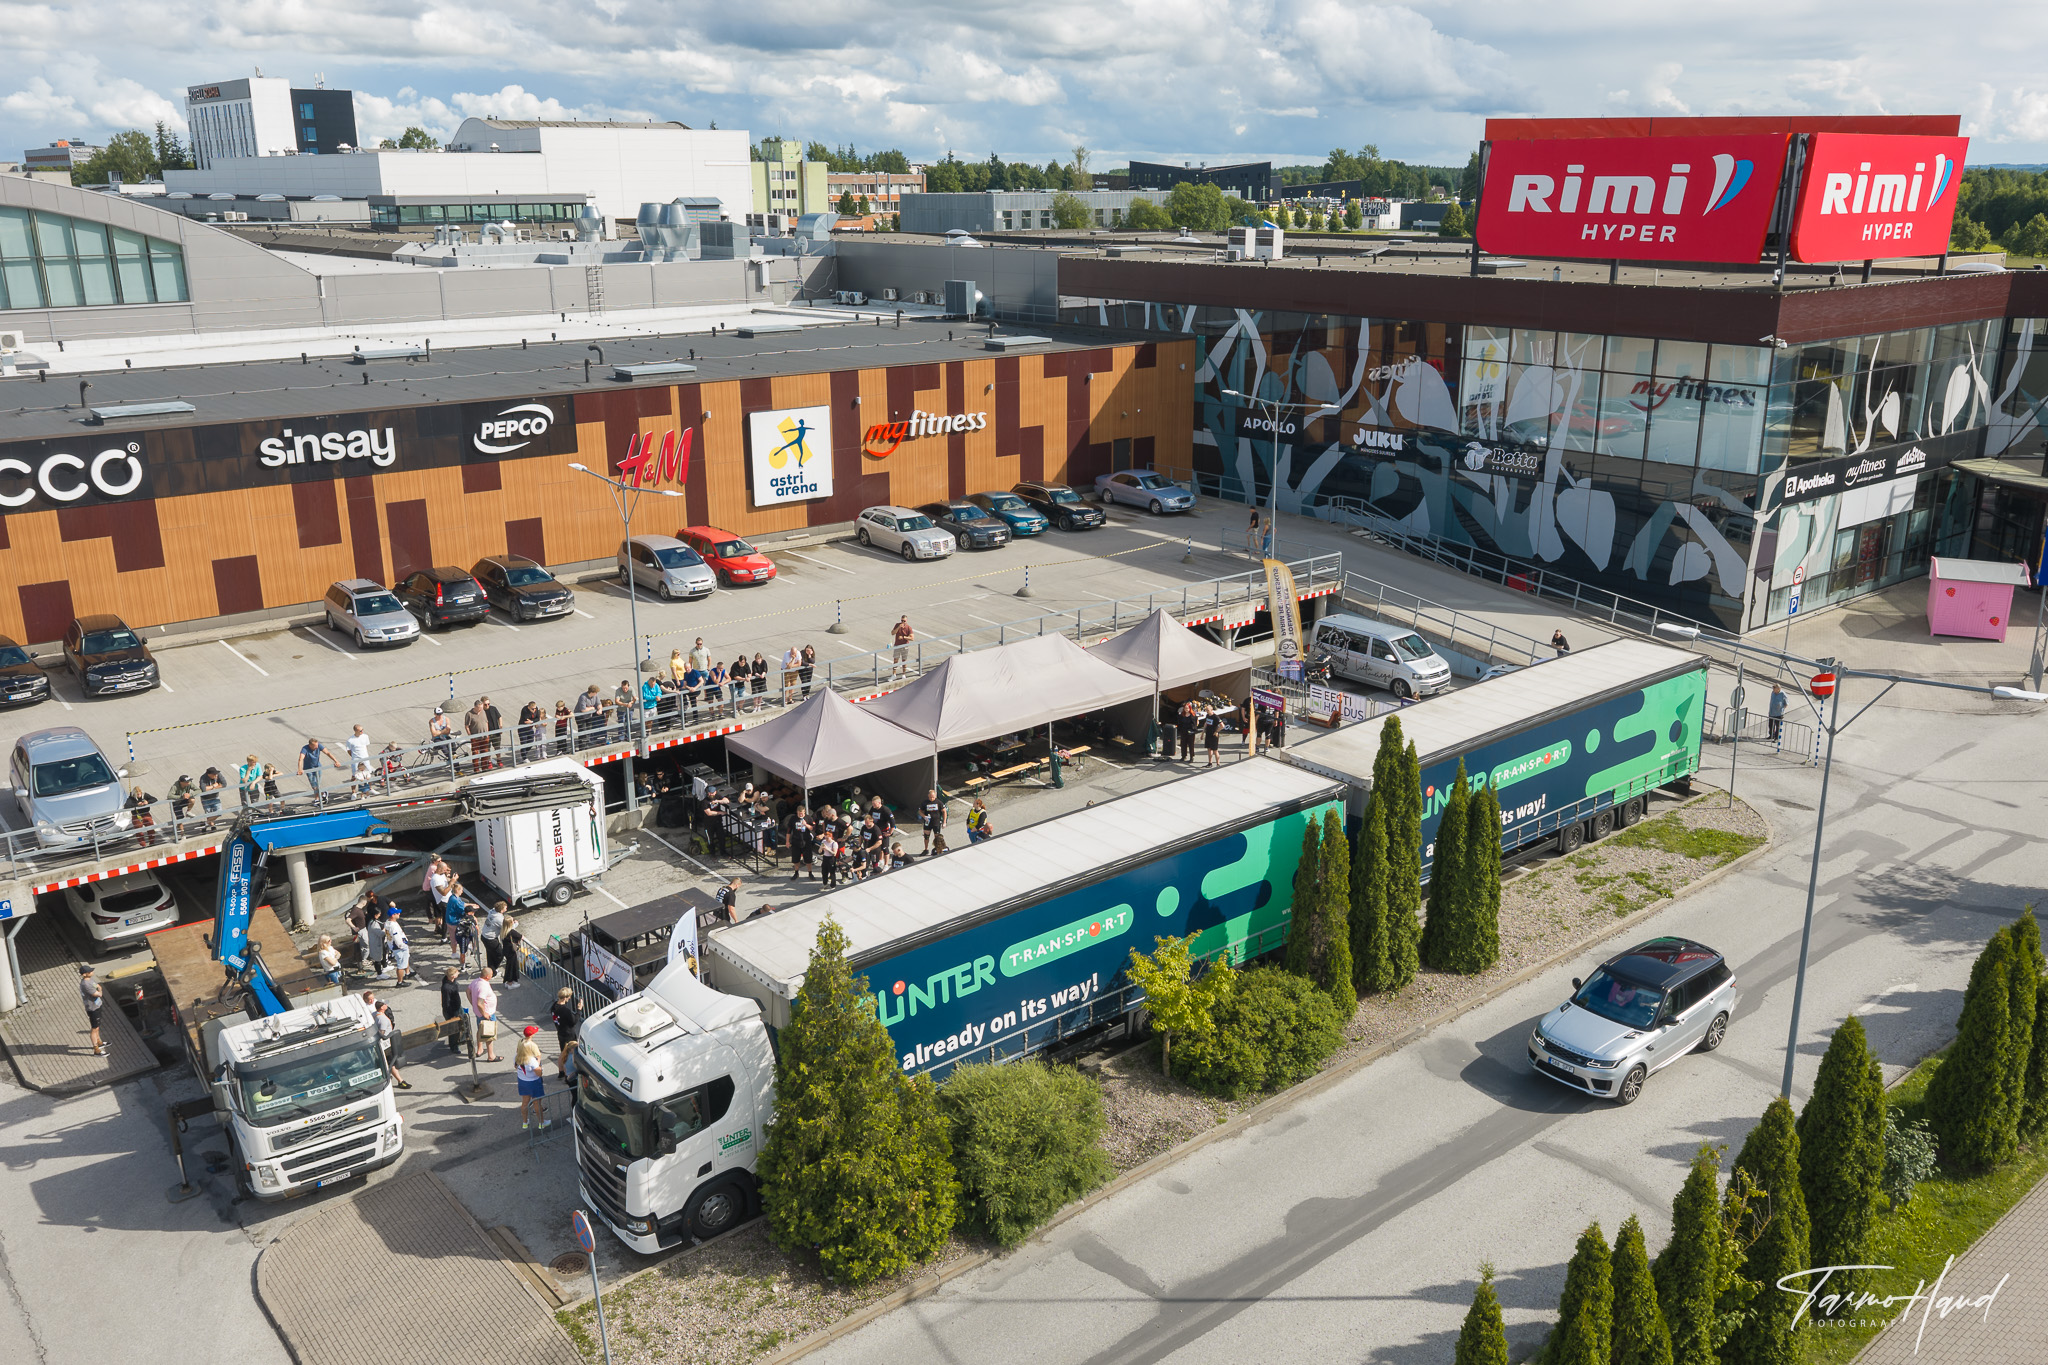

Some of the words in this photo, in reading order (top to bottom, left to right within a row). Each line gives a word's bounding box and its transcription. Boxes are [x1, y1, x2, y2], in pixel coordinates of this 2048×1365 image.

[1508, 163, 1690, 215] Rimi
[1820, 162, 1926, 215] Rimi
[1581, 223, 1677, 243] HYPER
[1862, 222, 1914, 241] HYPER
[1630, 375, 1757, 412] myfitness
[481, 414, 547, 442] PEPCO
[865, 409, 987, 458] myfitness
[1243, 416, 1296, 434] APOLLO
[260, 428, 396, 468] sinsay
[617, 427, 693, 487] H&M
[1492, 448, 1537, 469] Betta
[770, 472, 804, 489] astri
[1492, 465, 1535, 476] ZOOKAUPLUS
[1844, 459, 1887, 486] myfitness
[775, 480, 818, 497] arena
[1797, 472, 1836, 494] Apotheka
[1790, 598, 1797, 613] P
[1324, 703, 1364, 721] HADUS
[1516, 794, 1546, 821] way!
[231, 845, 243, 882] FASSI
[241, 878, 249, 896] 9057
[587, 960, 600, 976] POP
[903, 1018, 985, 1071] already
[991, 1010, 1016, 1033] on
[1021, 995, 1047, 1020] its
[1051, 973, 1099, 1012] way!
[309, 1114, 326, 1123] 5560
[327, 1109, 343, 1118] 9057
[266, 1126, 291, 1136] VOLVO
